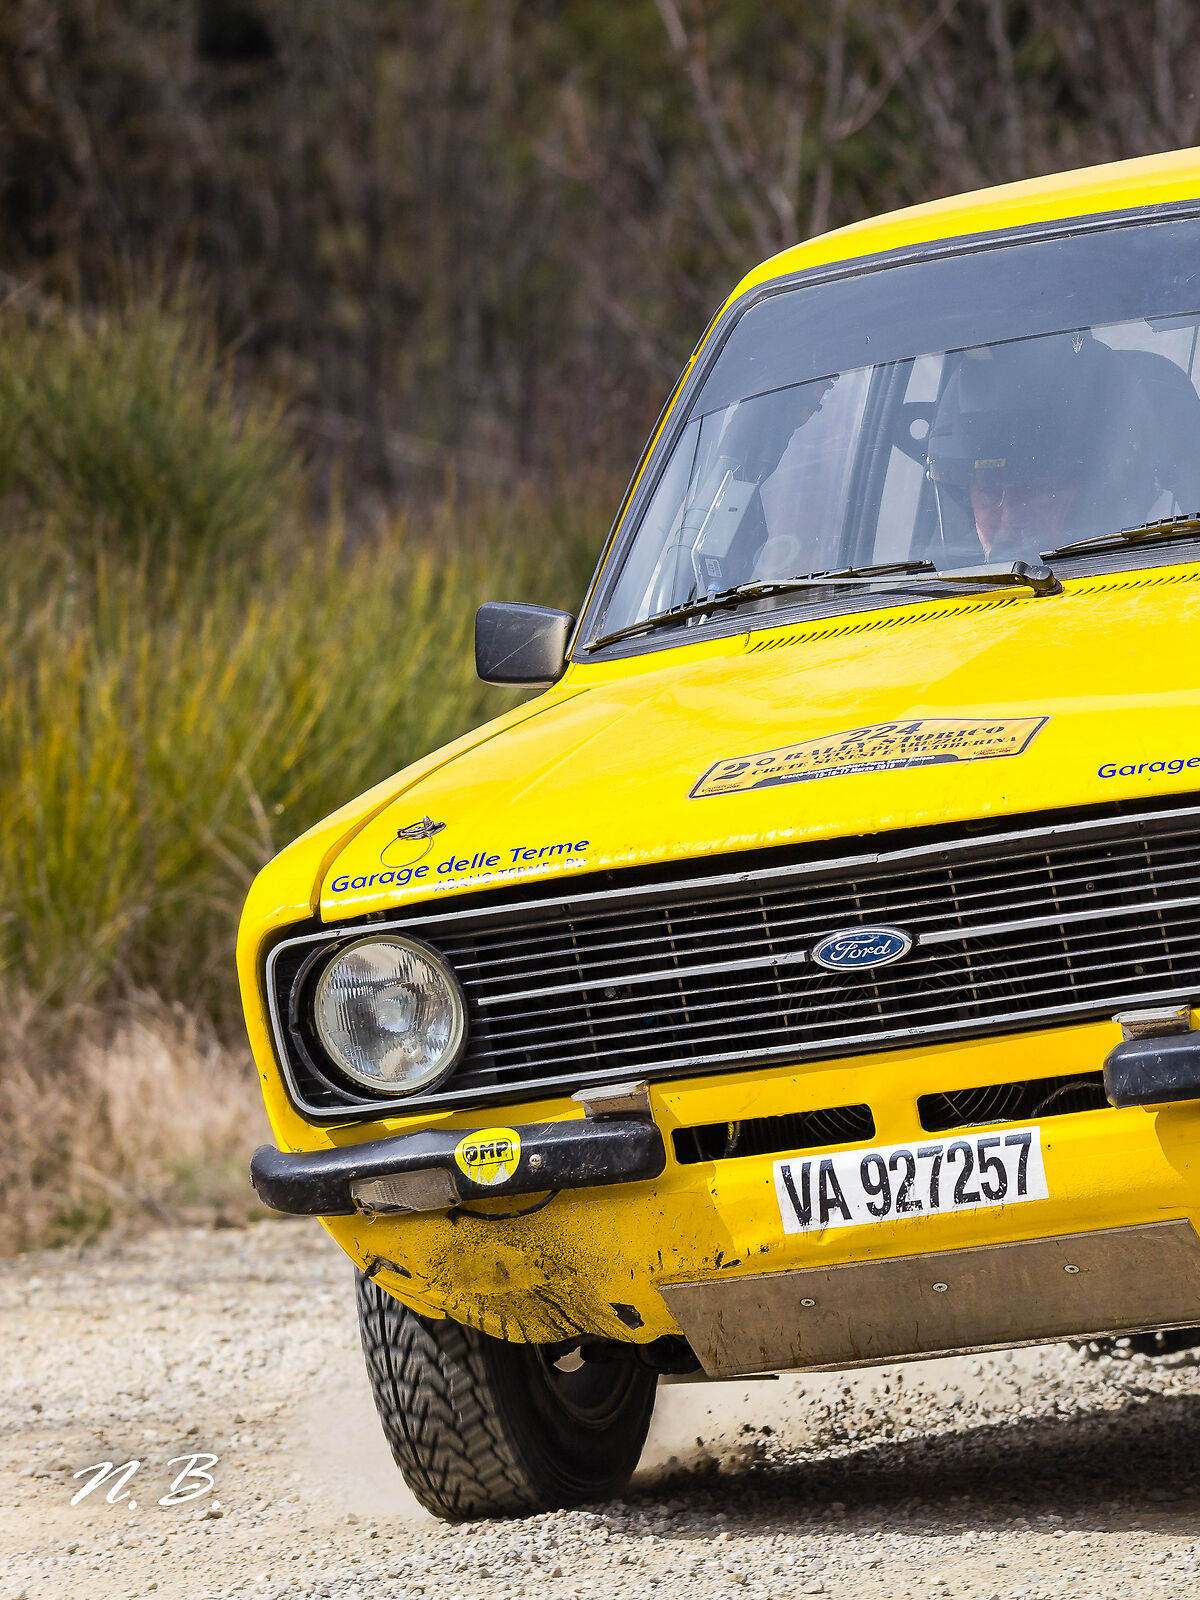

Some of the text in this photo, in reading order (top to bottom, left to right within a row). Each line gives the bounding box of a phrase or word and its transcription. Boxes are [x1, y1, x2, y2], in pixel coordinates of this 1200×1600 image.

[841, 721, 924, 744] 224
[880, 726, 1005, 747] STORICO
[331, 839, 590, 893] Garage delle Terme
[830, 936, 891, 961] Ford
[465, 1141, 509, 1162] OMP
[781, 1132, 1032, 1227] VA 927257
